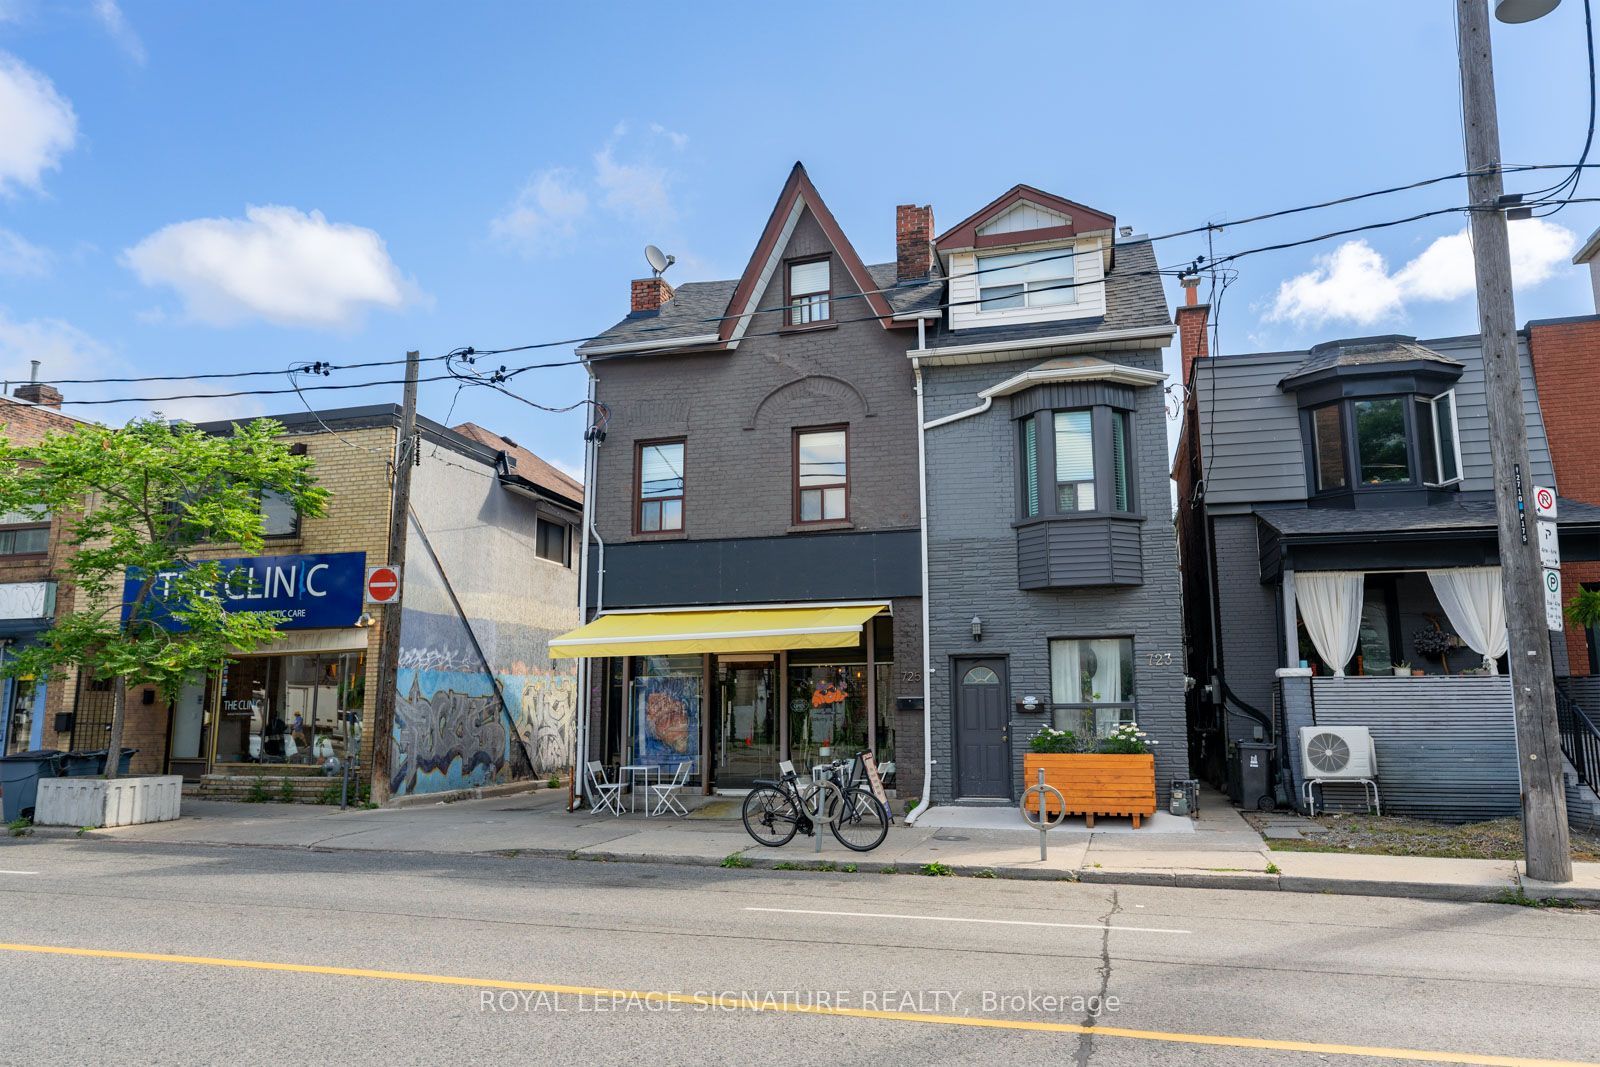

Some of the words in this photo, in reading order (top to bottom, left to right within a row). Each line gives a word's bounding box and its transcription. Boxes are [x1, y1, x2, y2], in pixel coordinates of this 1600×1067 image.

[1520, 513, 1528, 542] P175
[224, 563, 329, 600] CLINIC
[287, 609, 306, 618] CARE
[1146, 653, 1172, 665] 723
[901, 671, 921, 682] 725
[223, 701, 238, 710] THE
